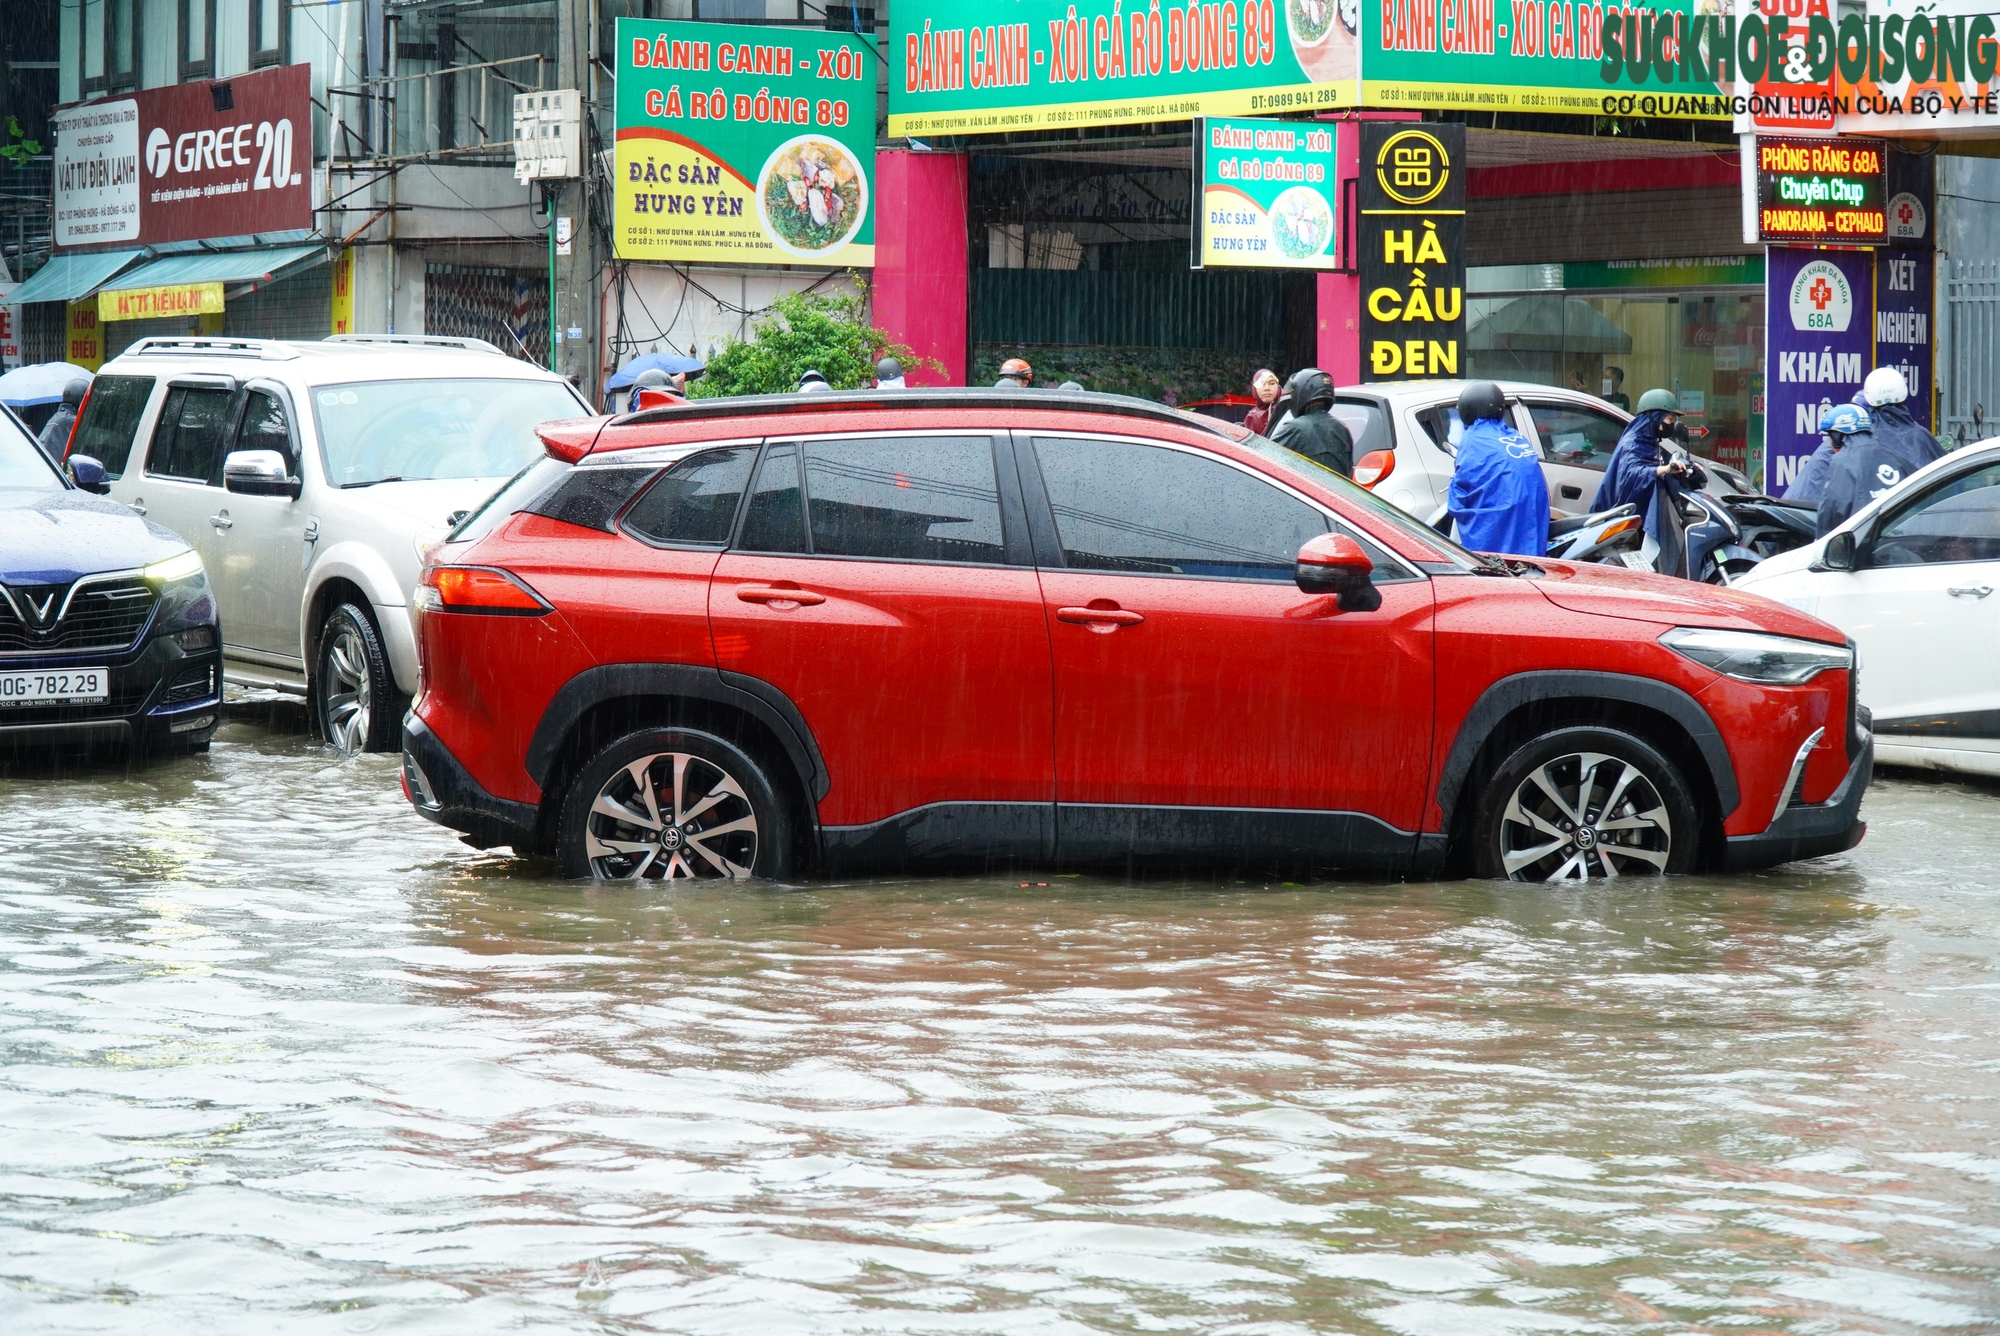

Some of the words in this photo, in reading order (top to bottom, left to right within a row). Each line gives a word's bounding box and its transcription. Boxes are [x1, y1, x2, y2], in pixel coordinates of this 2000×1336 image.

[1441, 0, 1495, 55] CANH
[632, 34, 710, 71] BÁNH
[718, 43, 793, 76] CANH
[816, 46, 863, 80] XÔI
[905, 20, 964, 93] BÁNH
[969, 23, 1030, 89] CANH
[1049, 11, 1088, 83] XÔI
[1094, 0, 1126, 79] CÁ
[1130, 0, 1164, 76] RÔ
[1244, 0, 1275, 67] 89
[645, 85, 683, 118] CÁ
[690, 88, 727, 120] RÔ
[734, 87, 810, 125] ĐỒNG
[816, 100, 849, 127] 89
[1295, 91, 1314, 105] 941
[1317, 89, 1337, 103] 289
[1380, 89, 1390, 100] CƠ
[1390, 89, 1400, 100] SỞ
[1408, 90, 1422, 101] NHƯ
[1422, 90, 1444, 102] QUỲNH
[1461, 92, 1475, 103] LÂM
[1496, 93, 1509, 104] YÊN
[1521, 94, 1530, 105] CƠ
[1531, 94, 1540, 105] SỞ
[1548, 96, 1559, 106] 111
[1560, 95, 1581, 107] PHÙNG
[931, 118, 945, 129] NHƯ
[946, 117, 966, 129] QUỲNH
[1020, 112, 1033, 124] YÊN
[1047, 112, 1056, 122] CƠ
[1057, 111, 1067, 122] SỞ
[1076, 110, 1088, 120] 111
[1089, 107, 1112, 120] PHÙNG
[1136, 104, 1155, 116] PHÚC
[1168, 102, 1179, 114] HÀ
[1179, 101, 1200, 113] ĐÔNG
[93, 135, 104, 146] CUNG
[1212, 125, 1251, 149] BÁNH
[1255, 130, 1295, 151] CANH
[1306, 129, 1331, 152] XÔI
[174, 123, 252, 173] GREE
[254, 118, 292, 190] 20
[1762, 143, 1809, 172] PHÒNG
[1812, 146, 1850, 173] RĂNG
[1852, 151, 1880, 174] 68A
[58, 156, 75, 200] VẬT
[76, 156, 88, 190] TƯ
[90, 151, 110, 196] ĐIỆN
[112, 155, 136, 194] LẠNH
[630, 157, 672, 188] ĐẶC
[678, 158, 721, 185] SẢN
[1218, 157, 1239, 179] CÁ
[1242, 158, 1262, 180] RÔ
[1263, 157, 1303, 182] ĐỒNG
[1306, 164, 1324, 182] 89
[634, 193, 696, 215] HƯNG
[702, 191, 744, 217] YÊN
[1781, 176, 1829, 206] Chuyên
[1830, 178, 1864, 206] Chụp
[1211, 208, 1232, 228] ĐẶC
[1235, 207, 1256, 225] SẢN
[1764, 210, 1827, 232] PANORAMA
[1835, 212, 1884, 233] CEPHALO
[1897, 226, 1914, 236] 68A
[670, 238, 692, 247] PHÙNG
[671, 227, 693, 237] QUỲNH
[748, 230, 760, 238] YÊN
[1246, 234, 1267, 250] YÊN
[1384, 219, 1447, 264] HÀ
[1794, 273, 1808, 304] PHÒNG
[1808, 263, 1827, 276] KHÁM
[1837, 278, 1848, 304] KHOA
[1888, 254, 1917, 292] XÉT
[1368, 268, 1462, 322] CẦU
[74, 310, 96, 330] KHO
[1808, 313, 1834, 328] 68A
[1877, 306, 1927, 351] NGHIỆM
[1370, 340, 1458, 374] ĐEN
[1779, 346, 1862, 383] KHÁM
[0, 674, 97, 695] 0G-782.29
